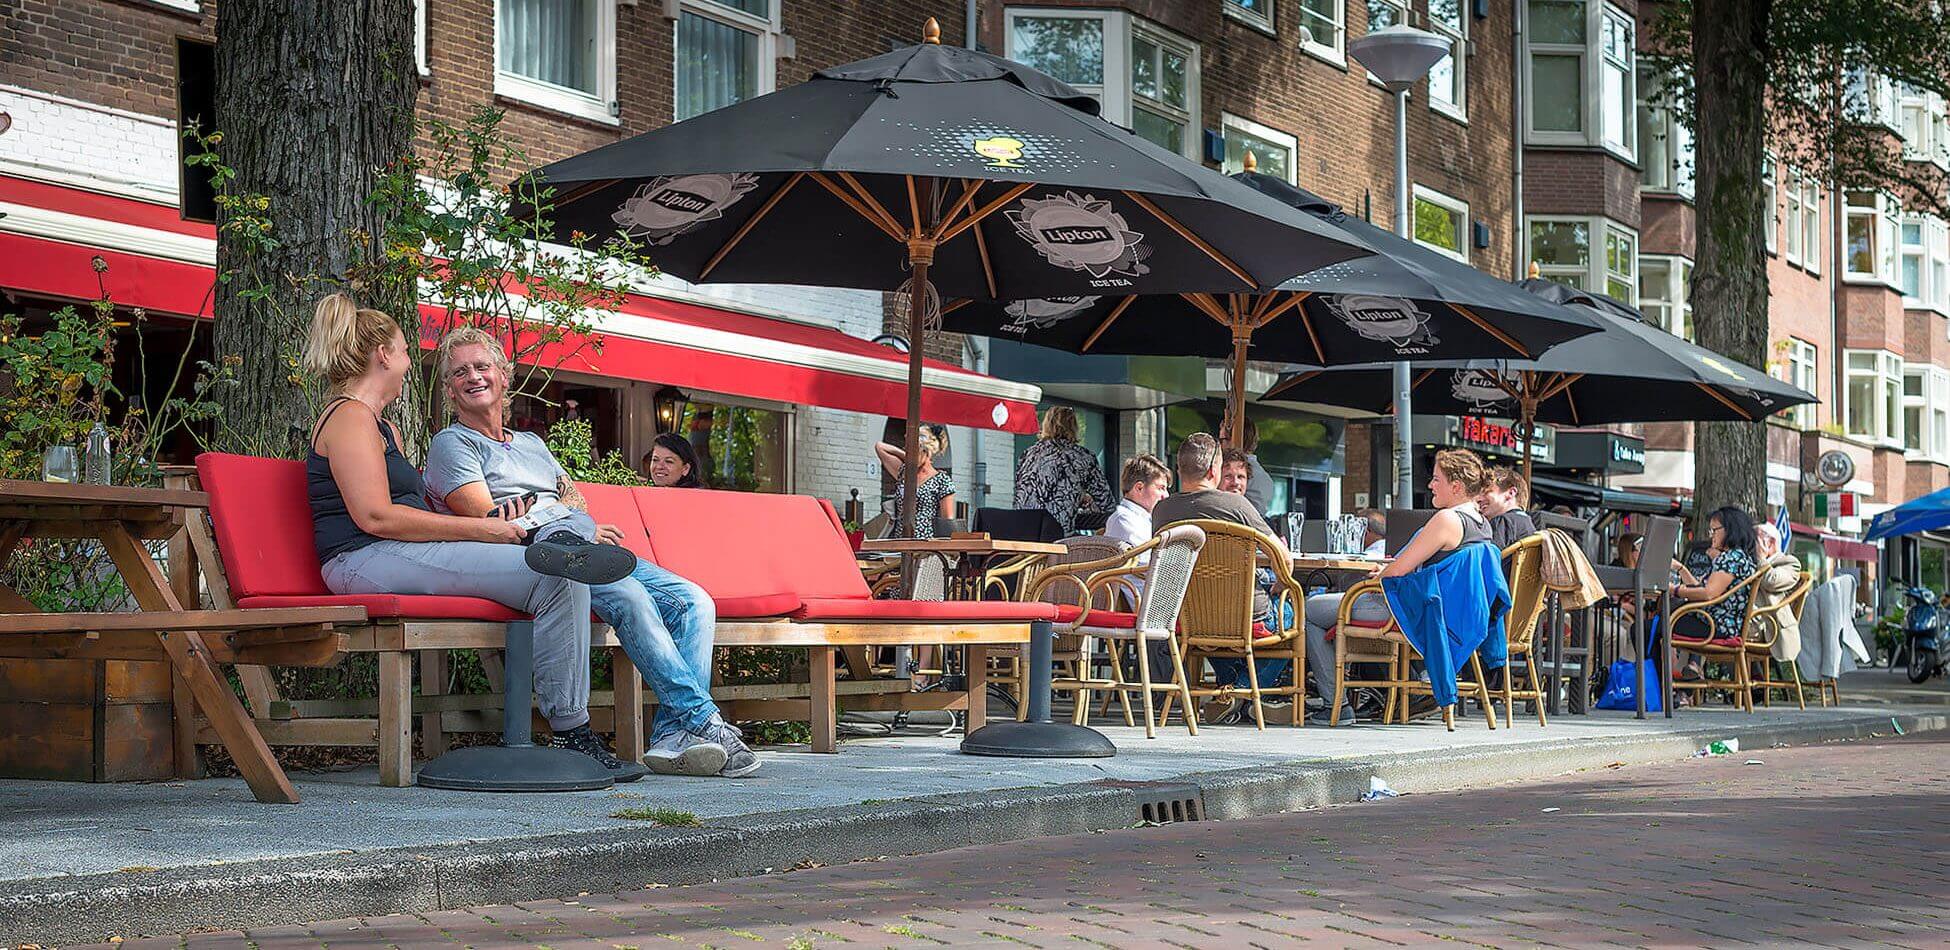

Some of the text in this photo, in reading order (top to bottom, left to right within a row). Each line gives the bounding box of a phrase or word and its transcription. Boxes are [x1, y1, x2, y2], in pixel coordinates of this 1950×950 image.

[1009, 167, 1036, 175] TEA
[658, 191, 706, 212] Lipton
[1046, 229, 1108, 243] Lipton
[1089, 279, 1134, 288] ICE TEA
[1354, 310, 1402, 321] Lipton
[1463, 416, 1516, 449] Takara
